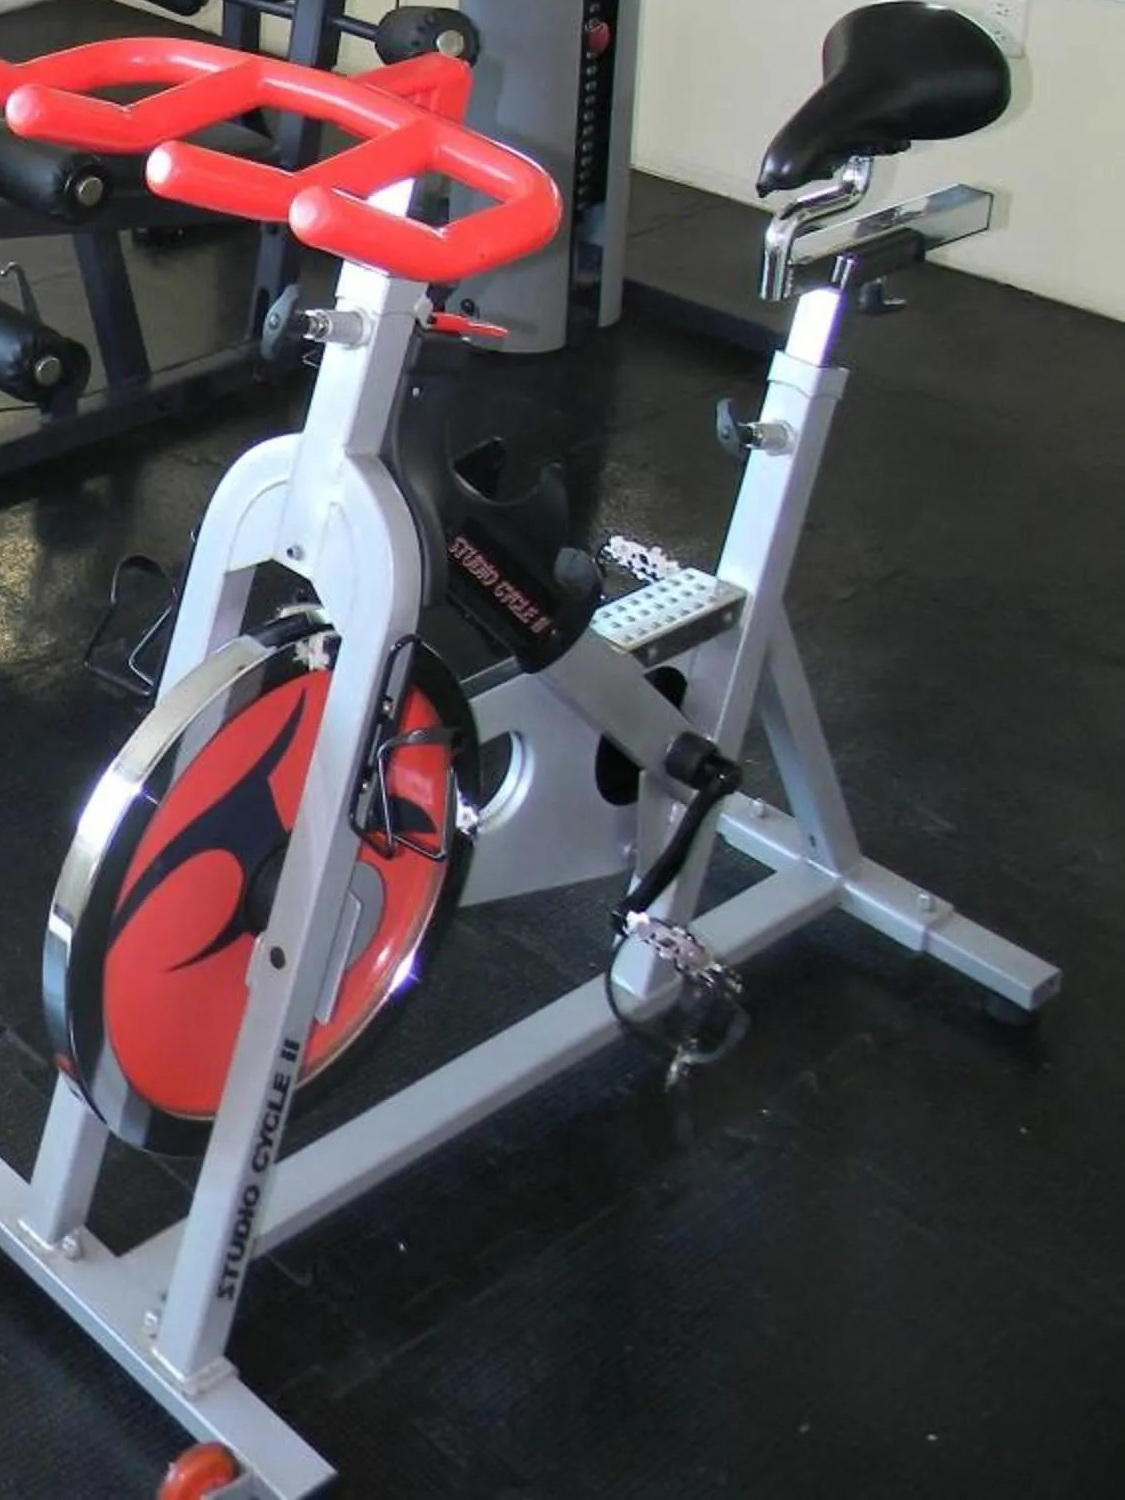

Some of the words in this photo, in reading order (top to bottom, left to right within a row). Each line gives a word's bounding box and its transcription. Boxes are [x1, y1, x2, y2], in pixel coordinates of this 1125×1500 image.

[447, 536, 500, 587] STUDIO
[216, 1183, 261, 1301] STUDIO
[251, 1073, 291, 1174] CYCLE
[281, 1038, 300, 1061] II
